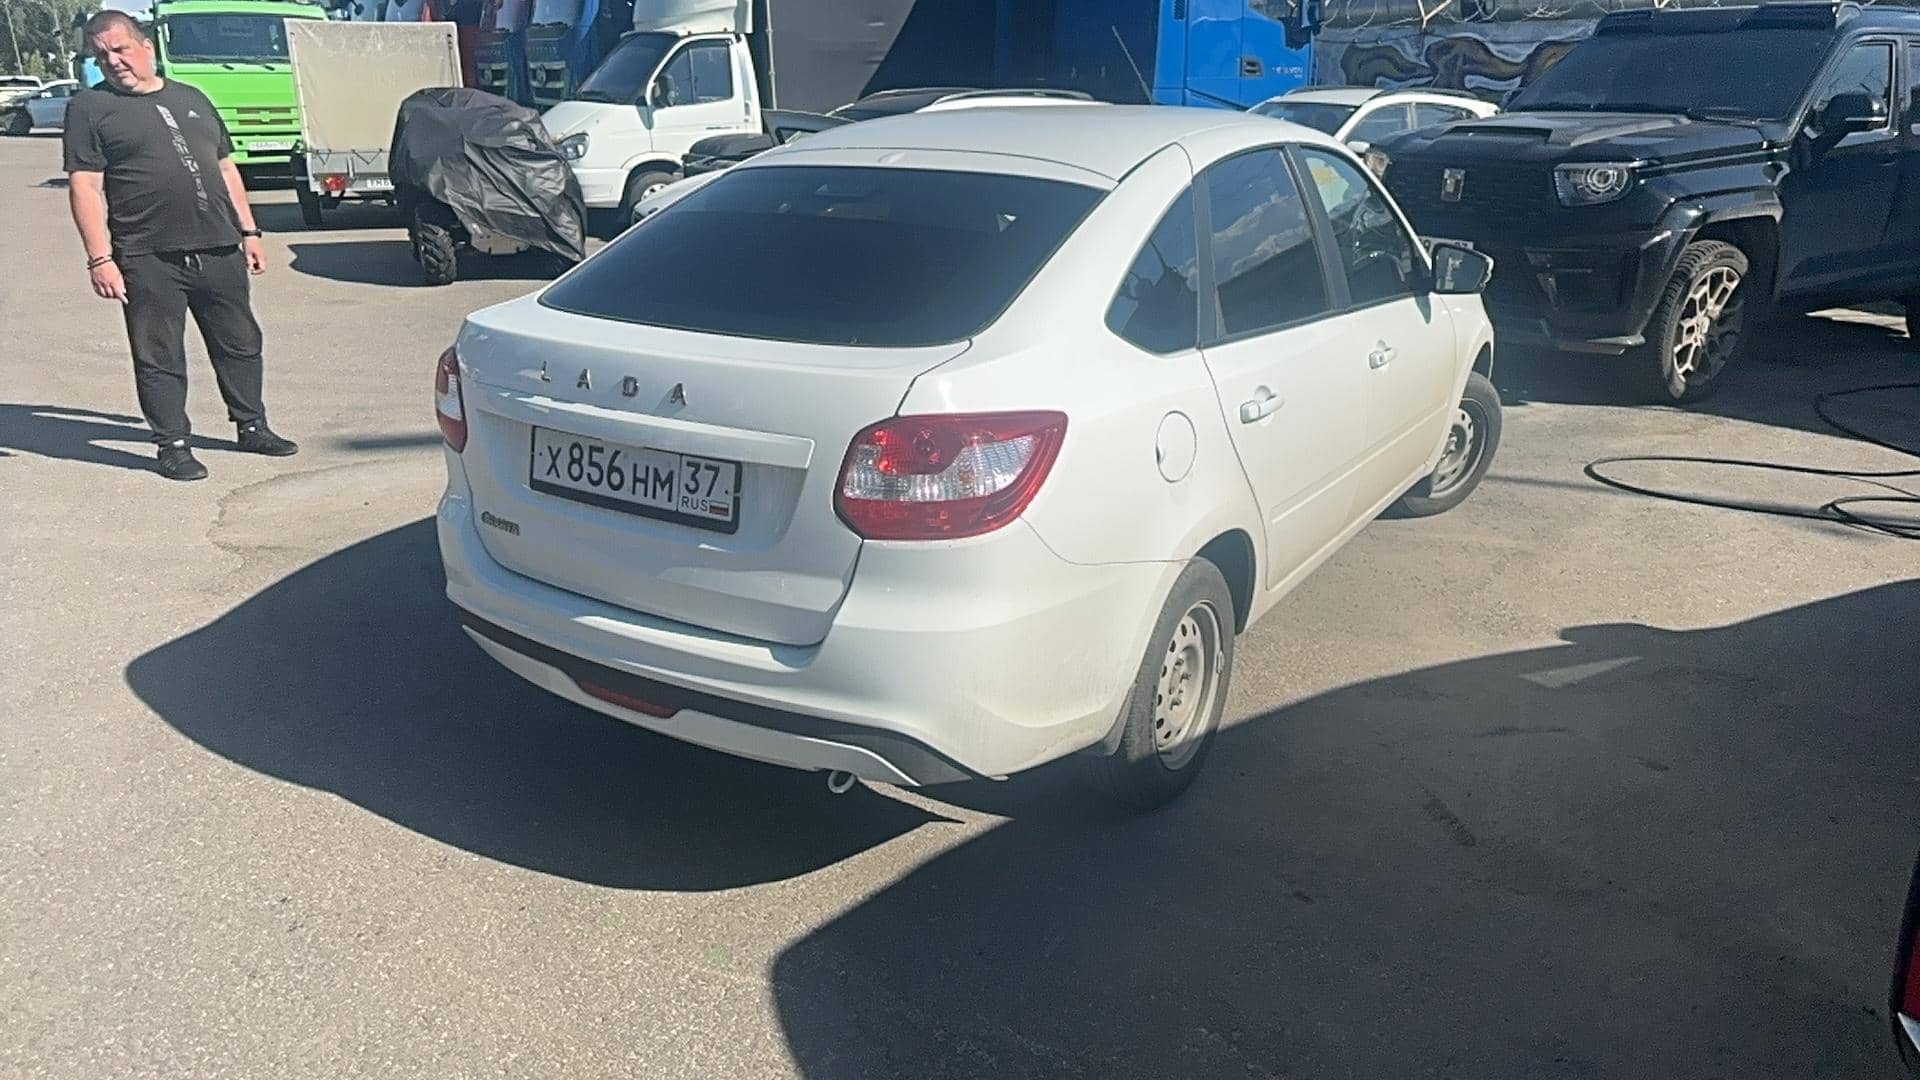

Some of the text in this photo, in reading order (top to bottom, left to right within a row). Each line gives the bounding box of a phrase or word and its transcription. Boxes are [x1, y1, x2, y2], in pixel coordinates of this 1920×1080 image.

[540, 360, 687, 405] LADA
[684, 461, 720, 497] 37
[681, 496, 708, 513] RUS
